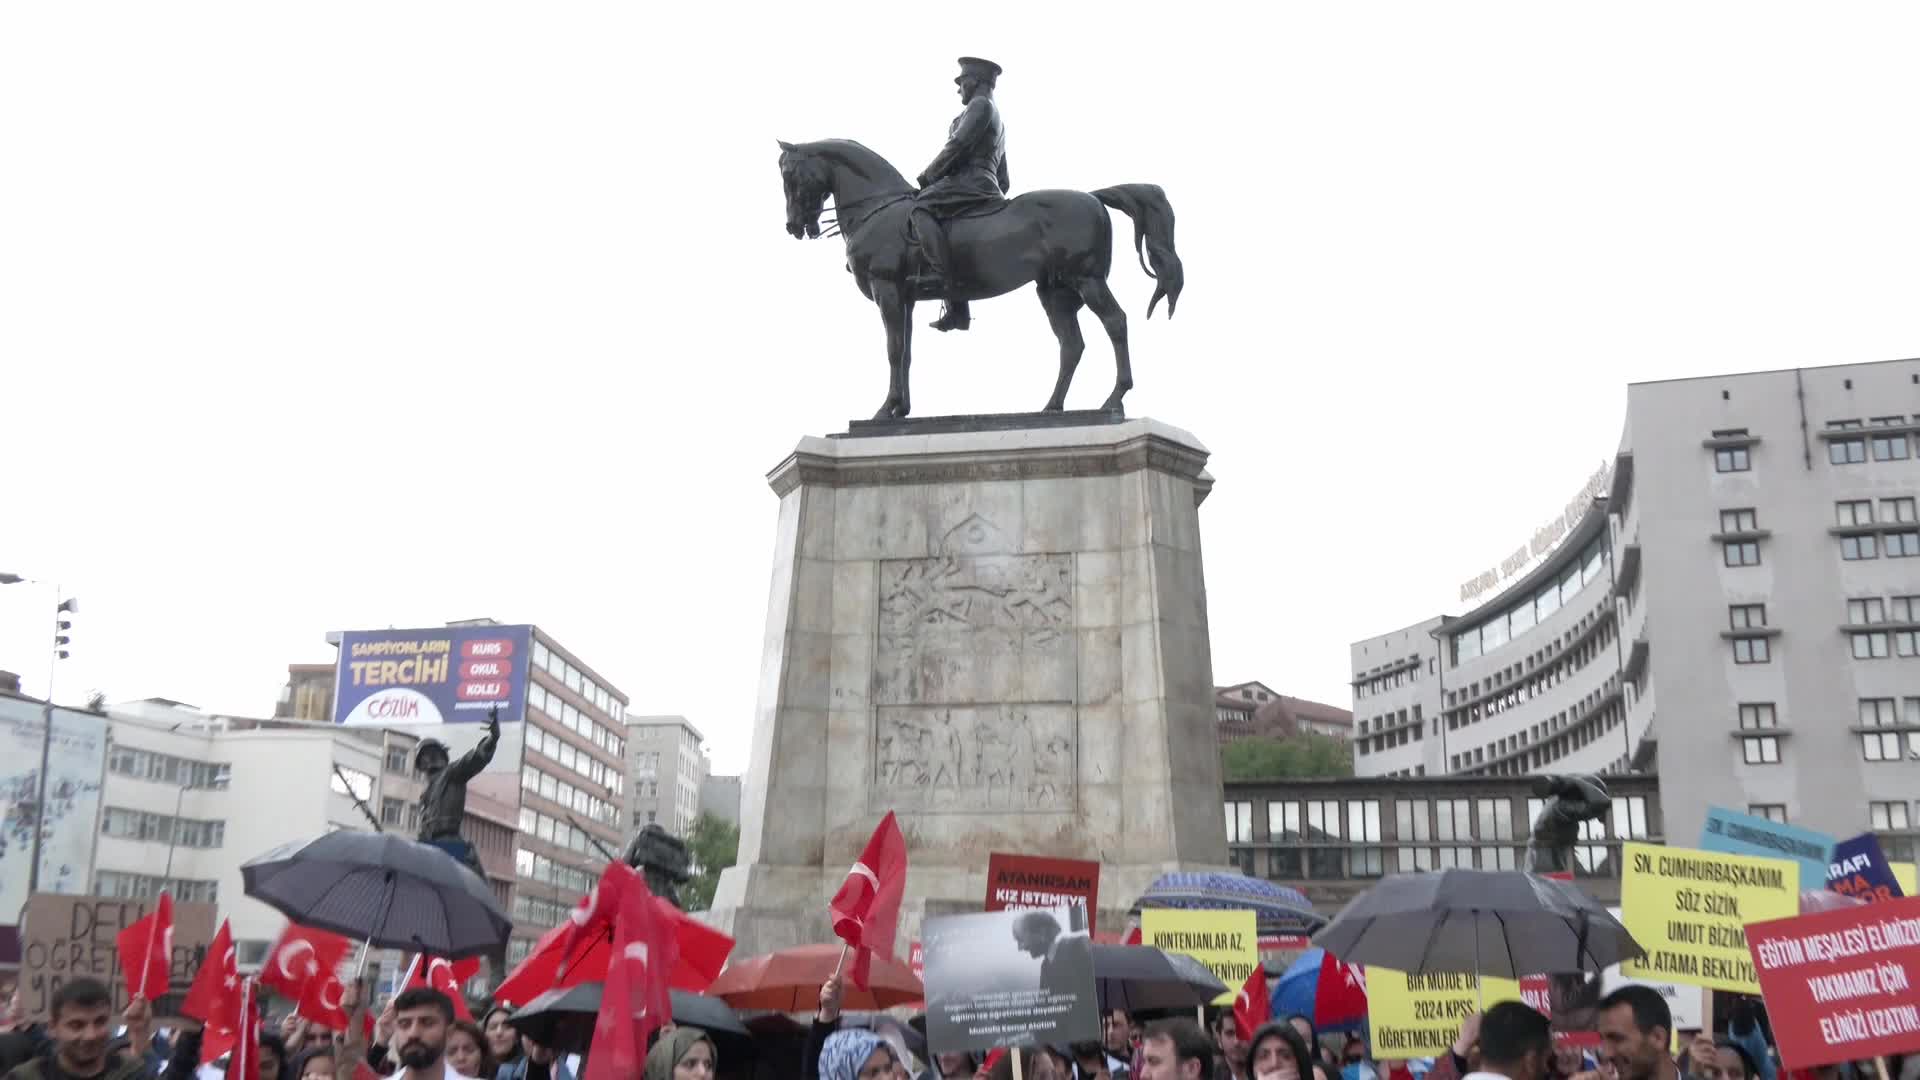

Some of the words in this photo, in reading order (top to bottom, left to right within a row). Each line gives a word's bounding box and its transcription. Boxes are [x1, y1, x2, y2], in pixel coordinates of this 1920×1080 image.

[471, 642, 502, 656] KURS
[350, 653, 449, 687] TERCİHİ
[469, 663, 500, 676] OKUL
[465, 682, 501, 697] KOLEJ
[1634, 853, 1655, 875] SN.
[1659, 855, 1787, 891] CUMHURBAŞKANIM,
[996, 887, 1018, 902] KIZ
[1676, 888, 1701, 912] SÖZ
[1704, 890, 1741, 919] SİZİN,
[1154, 931, 1227, 950] KONTENJANLAR
[1230, 932, 1246, 952] AZ,
[1668, 920, 1704, 945] UMUT
[1757, 936, 1805, 970] EĞİTİM
[1802, 923, 1869, 963] MEŞALESİ
[1866, 915, 1920, 951] ELİMİZD
[1654, 951, 1698, 976] ATAMA
[1703, 956, 1757, 983] BEKLİYO
[1806, 968, 1880, 1003] YAKMAMIZ
[1876, 960, 1909, 996] İÇİN
[1414, 1000, 1443, 1020] 2024
[1446, 999, 1475, 1018] KPSS
[1819, 1007, 1869, 1045] ELİNİZİ
